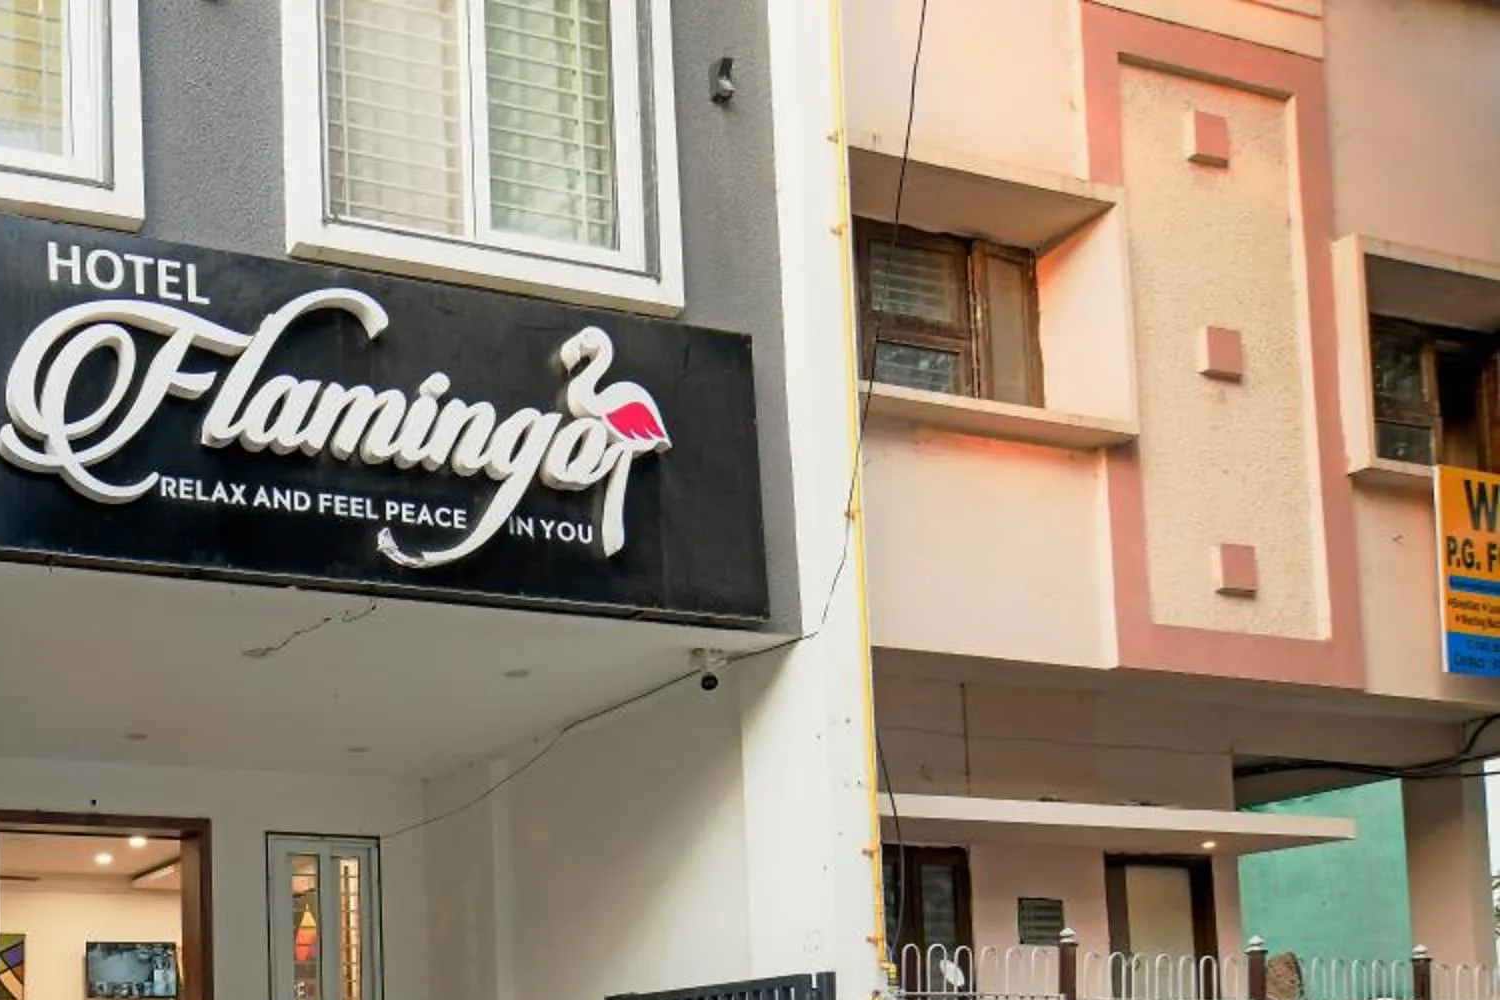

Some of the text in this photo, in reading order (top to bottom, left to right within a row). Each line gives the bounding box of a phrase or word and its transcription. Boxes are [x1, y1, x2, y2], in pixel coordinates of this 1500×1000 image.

[47, 241, 211, 305] HOTEL
[160, 476, 594, 545] RELAX AND FEEL PEACE IN YOU
[1445, 535, 1500, 573] P.G. F
